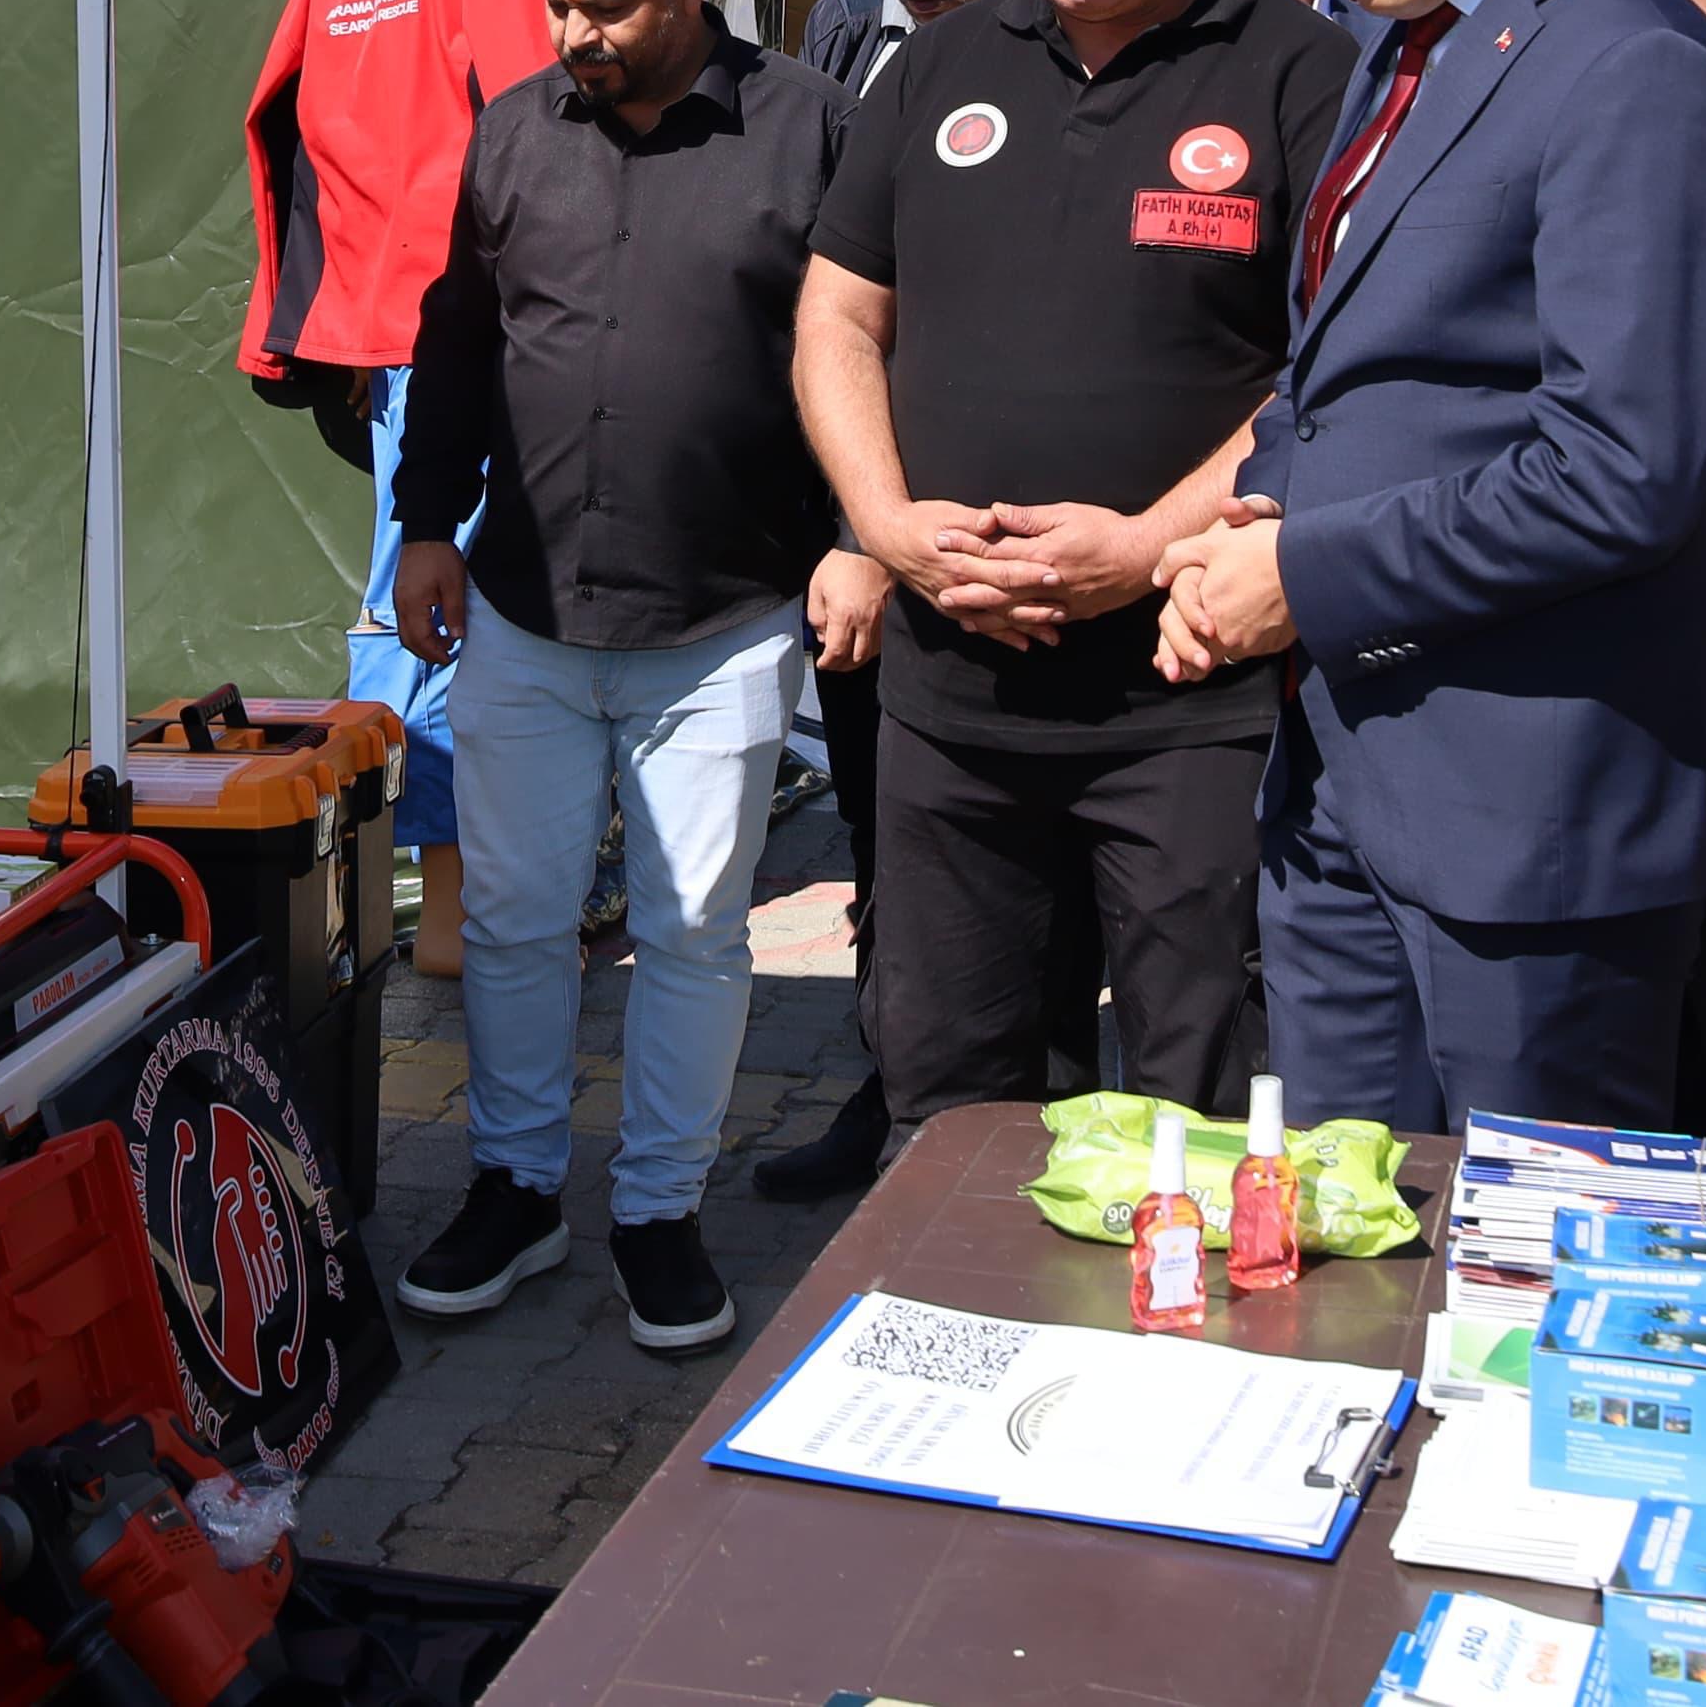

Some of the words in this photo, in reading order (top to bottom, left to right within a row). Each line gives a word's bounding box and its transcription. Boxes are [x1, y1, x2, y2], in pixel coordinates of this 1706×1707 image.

[1141, 195, 1182, 215] FATİH
[1188, 199, 1252, 224] KARATAŞ
[1167, 219, 1178, 234] A
[132, 1017, 230, 1137] KURTARMA
[232, 1031, 281, 1103] 1995
[1107, 1205, 1131, 1223] 90
[288, 1423, 318, 1473] DAK
[313, 1402, 332, 1441] 95
[1458, 1625, 1488, 1662] AFAD
